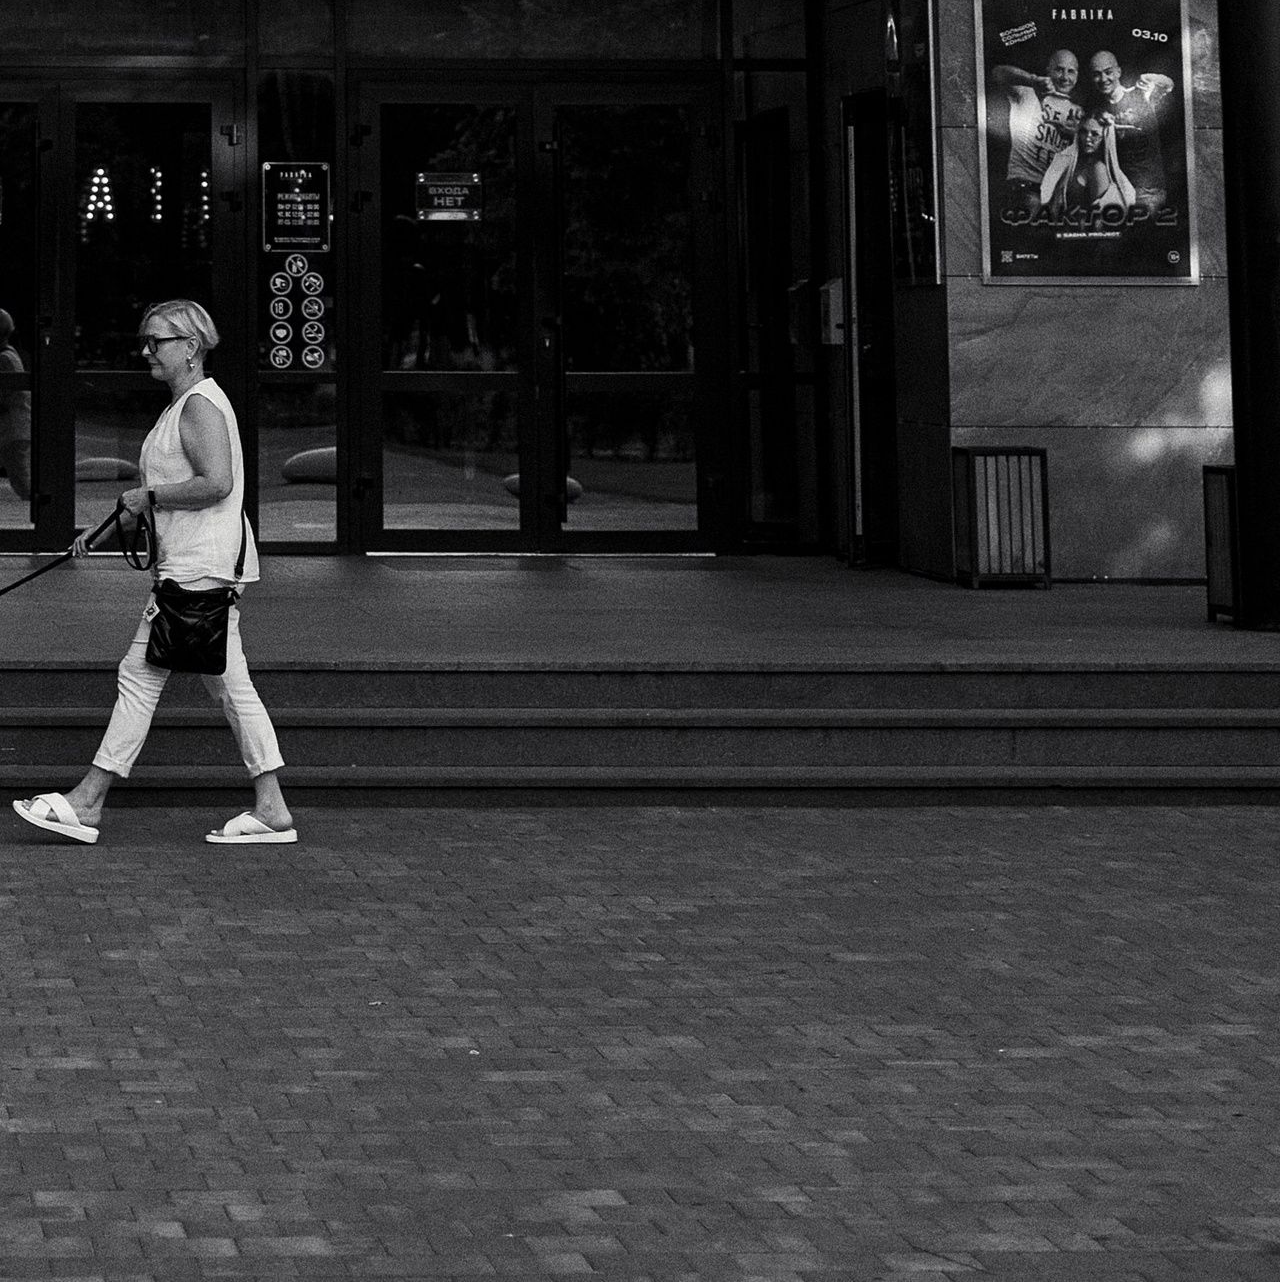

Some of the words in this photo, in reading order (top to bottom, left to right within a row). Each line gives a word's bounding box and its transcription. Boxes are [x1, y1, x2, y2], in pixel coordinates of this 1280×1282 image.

[1052, 8, 1114, 20] FABRIKA
[1131, 28, 1168, 43] 03.10
[428, 187, 470, 195] ВХОДА
[434, 197, 465, 207] НЕТ
[999, 203, 1151, 226] ФАКТОР
[1154, 204, 1178, 226] 2
[274, 302, 284, 314] 18
